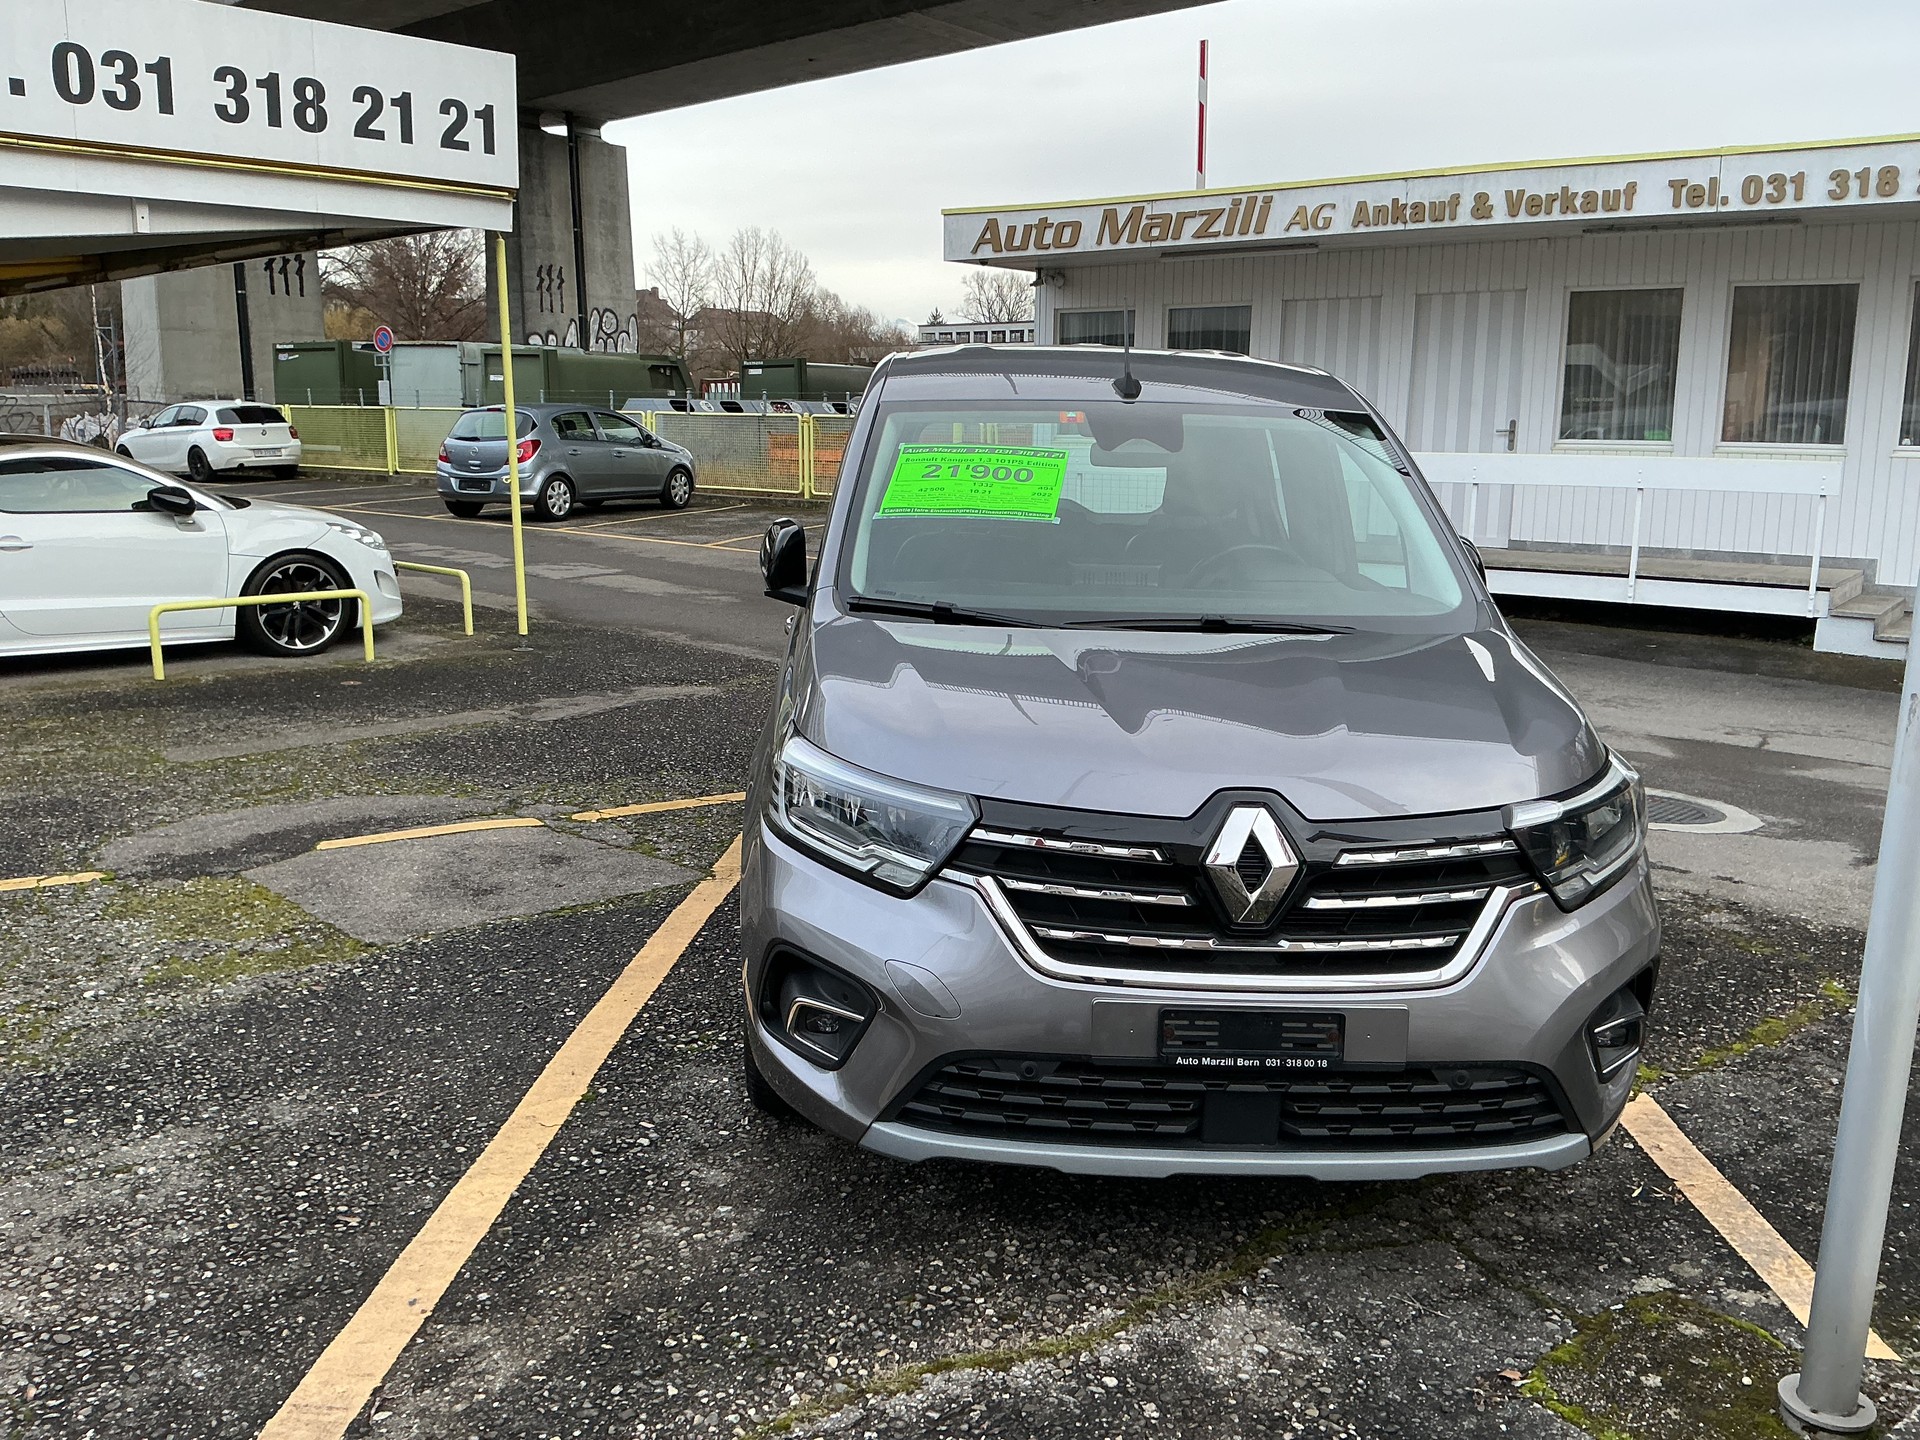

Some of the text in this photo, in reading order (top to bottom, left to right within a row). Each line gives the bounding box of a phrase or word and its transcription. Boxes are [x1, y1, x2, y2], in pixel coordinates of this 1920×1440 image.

[52, 41, 496, 155] 031 318 21 21
[970, 218, 1082, 254] Auto
[1095, 195, 1274, 245] Marzili
[1283, 202, 1335, 232] AG
[1351, 193, 1461, 227] Ankauf
[1471, 192, 1494, 220] &
[1504, 181, 1638, 217] Verkauf
[1668, 177, 1729, 208] Tel.
[1741, 171, 1806, 205] 031
[1828, 165, 1900, 200] 318
[921, 464, 1034, 482] 21'900
[1176, 1056, 1199, 1065] Auto
[1202, 1057, 1234, 1066] Marzili
[1237, 1058, 1260, 1066] Bern
[1304, 1059, 1315, 1067] 00
[1317, 1059, 1328, 1068] 18
